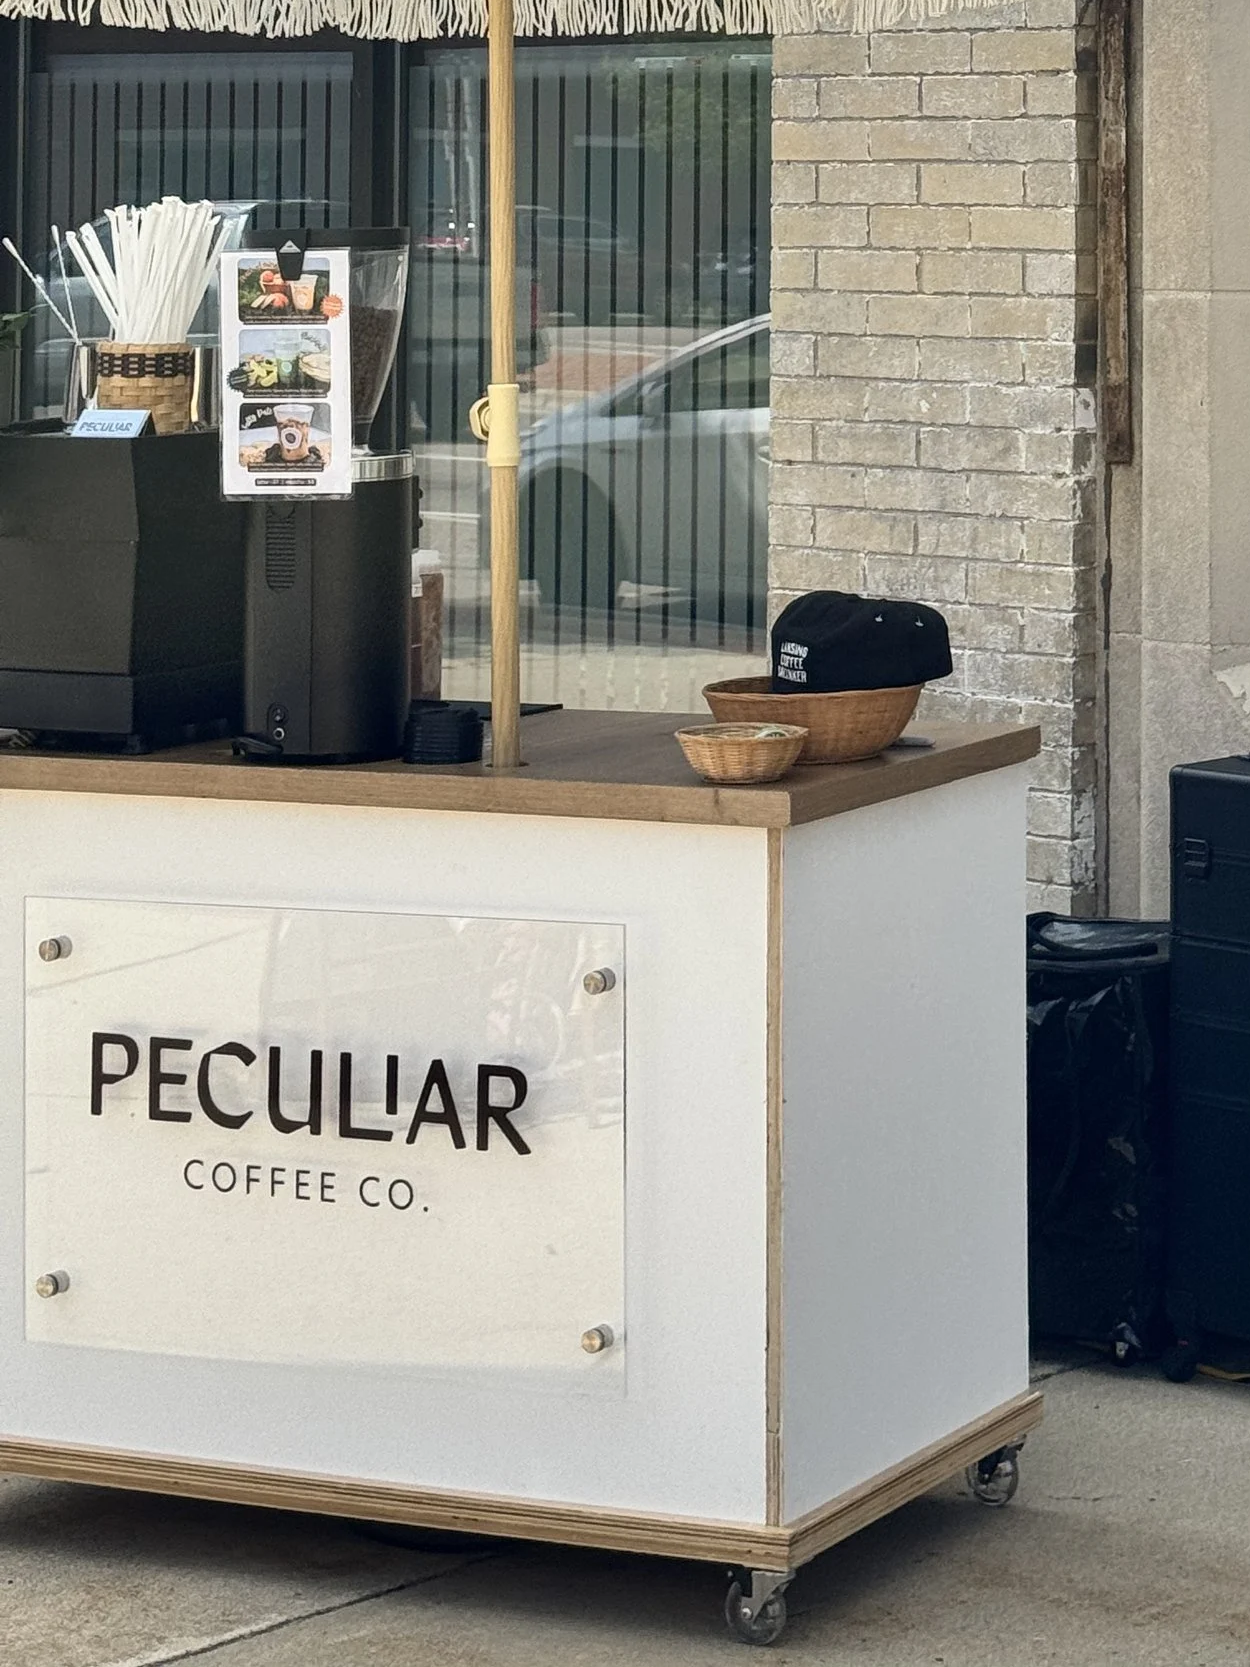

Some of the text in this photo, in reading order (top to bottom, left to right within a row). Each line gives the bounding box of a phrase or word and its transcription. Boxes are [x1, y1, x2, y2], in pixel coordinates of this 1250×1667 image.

[780, 653, 804, 670] COFFEE
[90, 1031, 532, 1156] PECULIAR
[183, 1158, 430, 1212] COFFEE CO.
